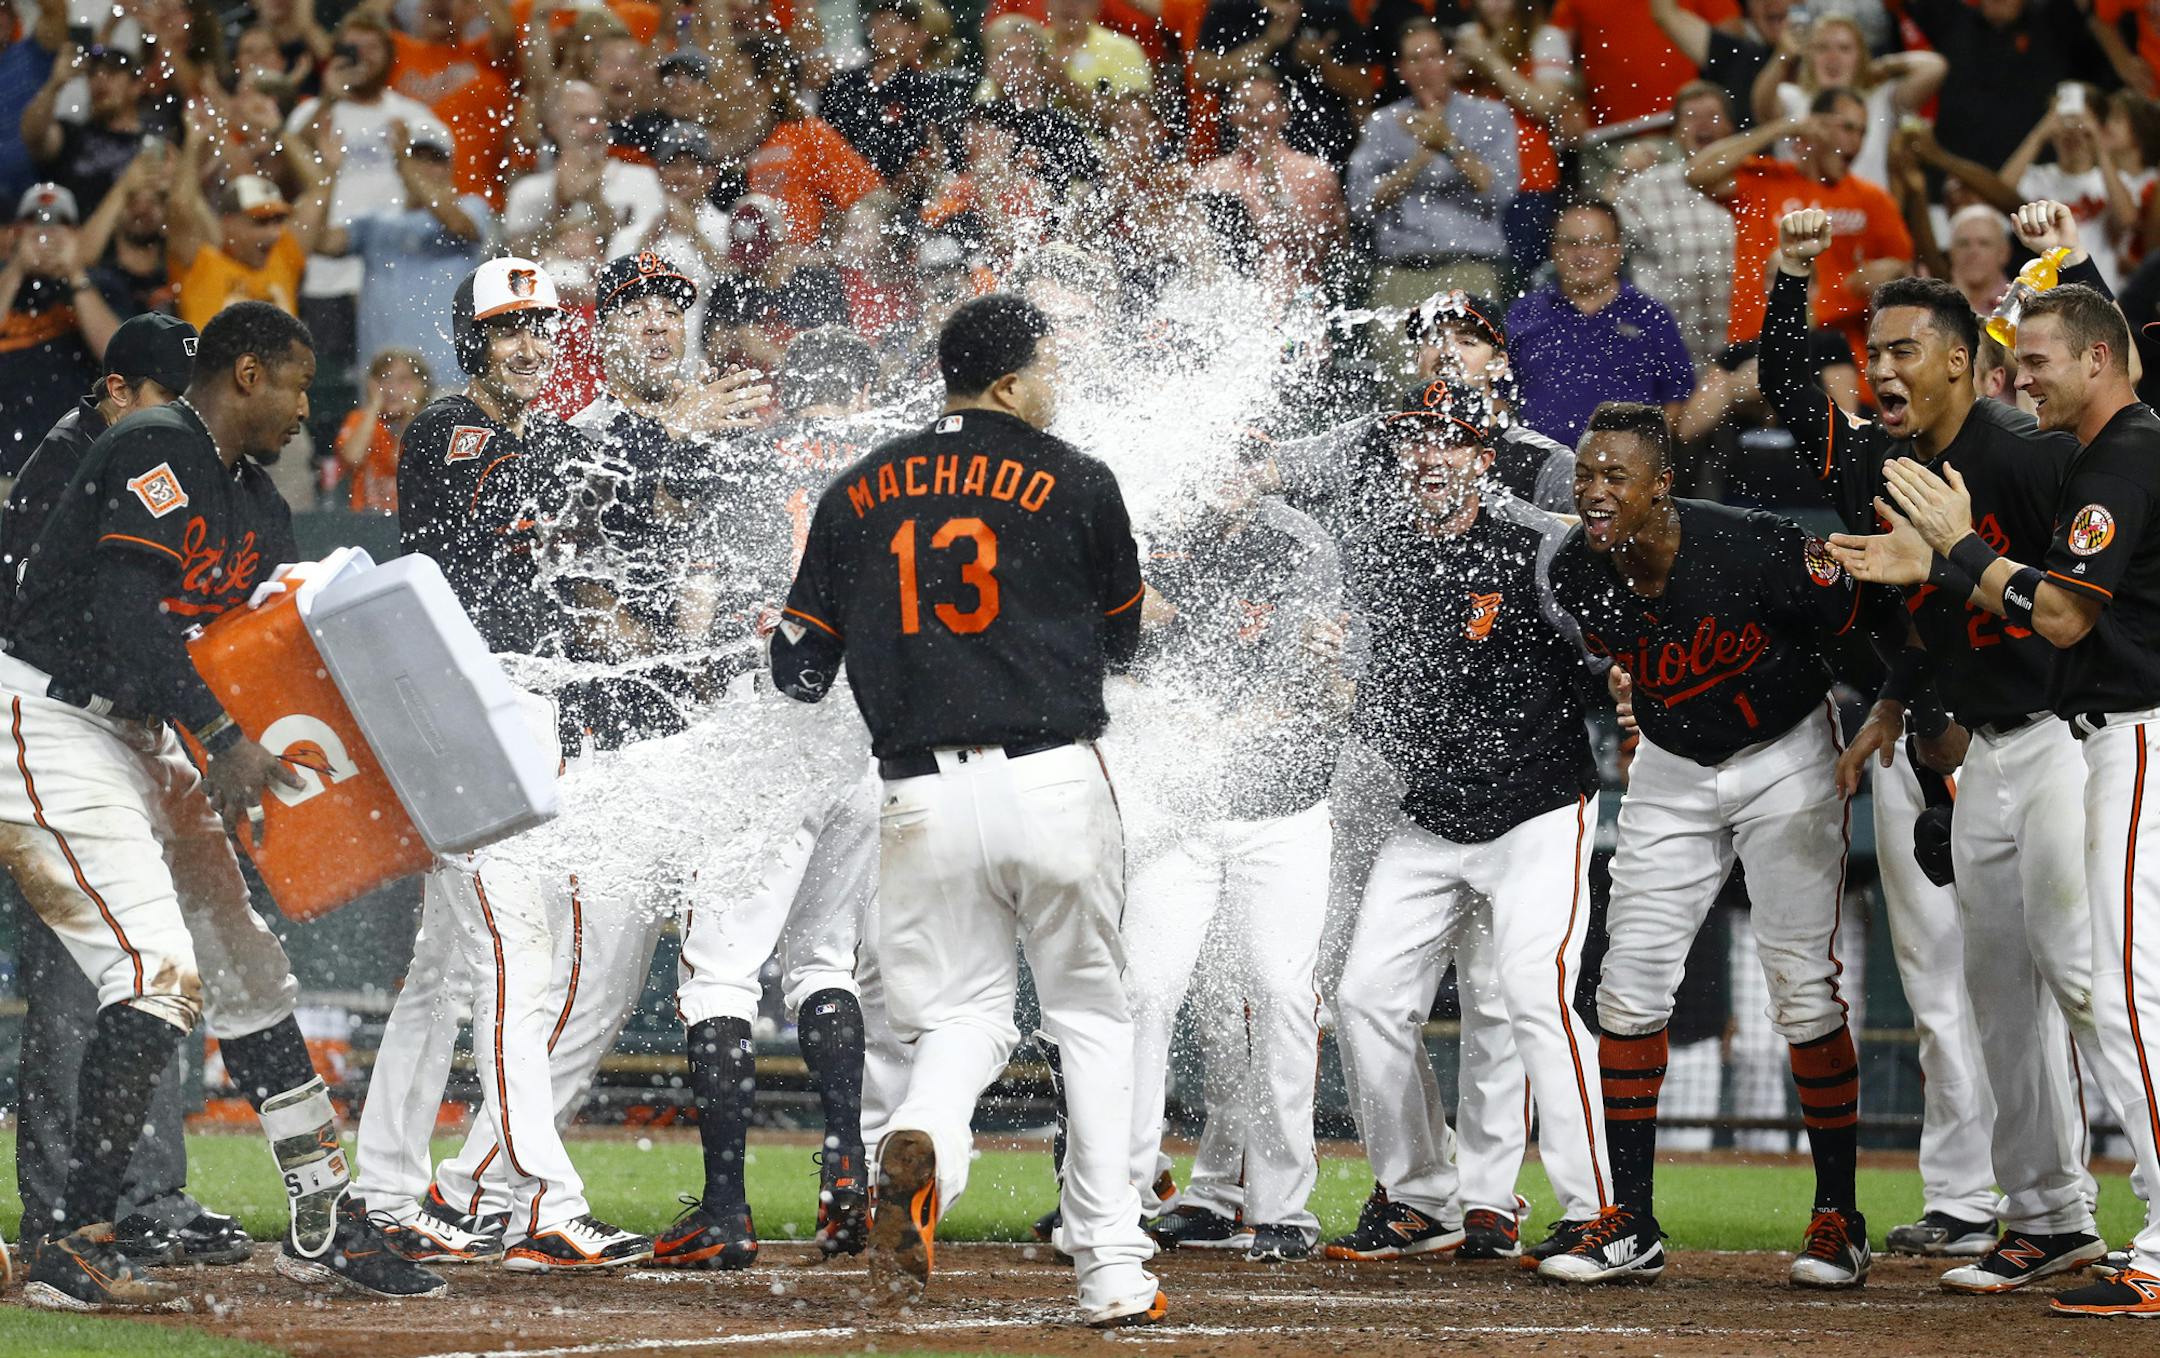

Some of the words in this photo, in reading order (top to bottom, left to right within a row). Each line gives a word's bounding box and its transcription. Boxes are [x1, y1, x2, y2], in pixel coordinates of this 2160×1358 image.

[149, 480, 173, 501] 25
[848, 455, 1056, 519] MACHADO
[891, 517, 1000, 634] 13
[1733, 691, 1760, 729] 1
[1602, 1234, 1638, 1266] NIKE
